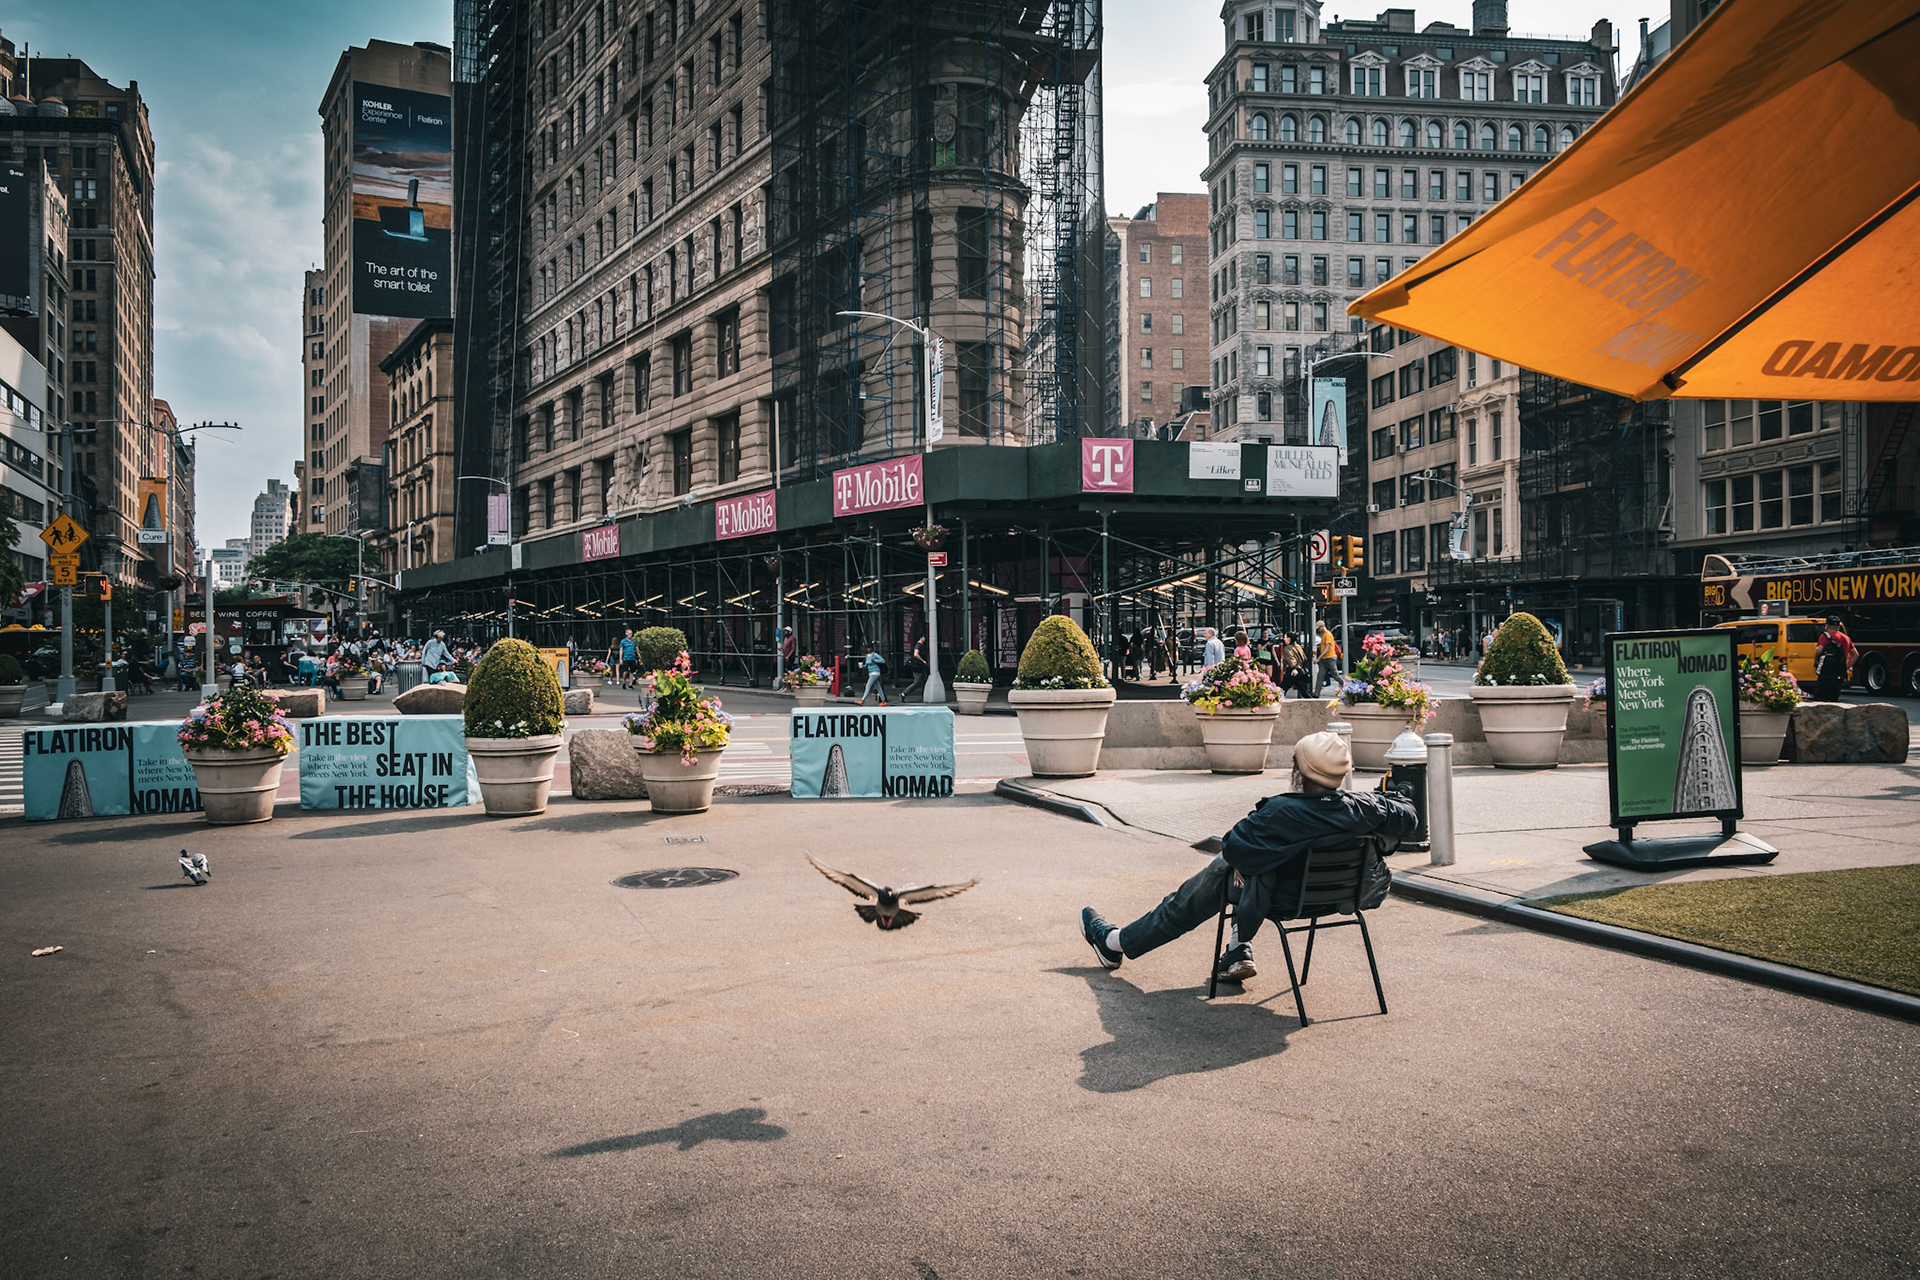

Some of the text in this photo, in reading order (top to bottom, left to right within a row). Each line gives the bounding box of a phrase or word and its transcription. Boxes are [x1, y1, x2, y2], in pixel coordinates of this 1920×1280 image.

[362, 107, 402, 119] Experience
[362, 114, 387, 124] Center
[418, 115, 442, 125] Flatiron
[365, 261, 438, 280] The art of the
[374, 279, 433, 293] smart toilet.
[1304, 469, 1332, 479] FELD
[855, 463, 920, 509] Mobile
[731, 497, 773, 533] Mobile
[142, 533, 162, 541] Cure
[592, 530, 618, 557] Mobile
[61, 567, 70, 577] 5
[100, 580, 106, 591] 4
[1704, 585, 1716, 596] BIG
[1826, 575, 1869, 600] NEW
[1321, 589, 1328, 599] 4
[1615, 640, 1681, 661] FLATIRON
[1677, 653, 1728, 674] NOMAD
[1616, 666, 1651, 678] Where
[1617, 675, 1665, 689] New York
[1617, 689, 1647, 700] Meets
[1618, 697, 1665, 711] New York
[793, 714, 887, 741] FLATIRON
[301, 721, 399, 749] THE BEST
[24, 726, 134, 758] FLATIRON
[889, 746, 908, 754] Take
[916, 745, 929, 753] the
[137, 757, 158, 767] Take
[159, 756, 168, 766] in
[168, 757, 182, 765] the
[307, 754, 326, 762] Take
[336, 753, 348, 761] the
[889, 753, 913, 761] where
[930, 753, 947, 761] York
[137, 765, 194, 775] where New Yo
[307, 761, 331, 770] where
[350, 761, 368, 769] York
[376, 753, 453, 780] SEAT IN
[138, 775, 164, 783] meets
[165, 774, 184, 782] New
[308, 770, 330, 778] meets
[332, 770, 350, 778] New
[882, 774, 953, 797] NOMAD
[334, 784, 449, 809] THE HOUSE
